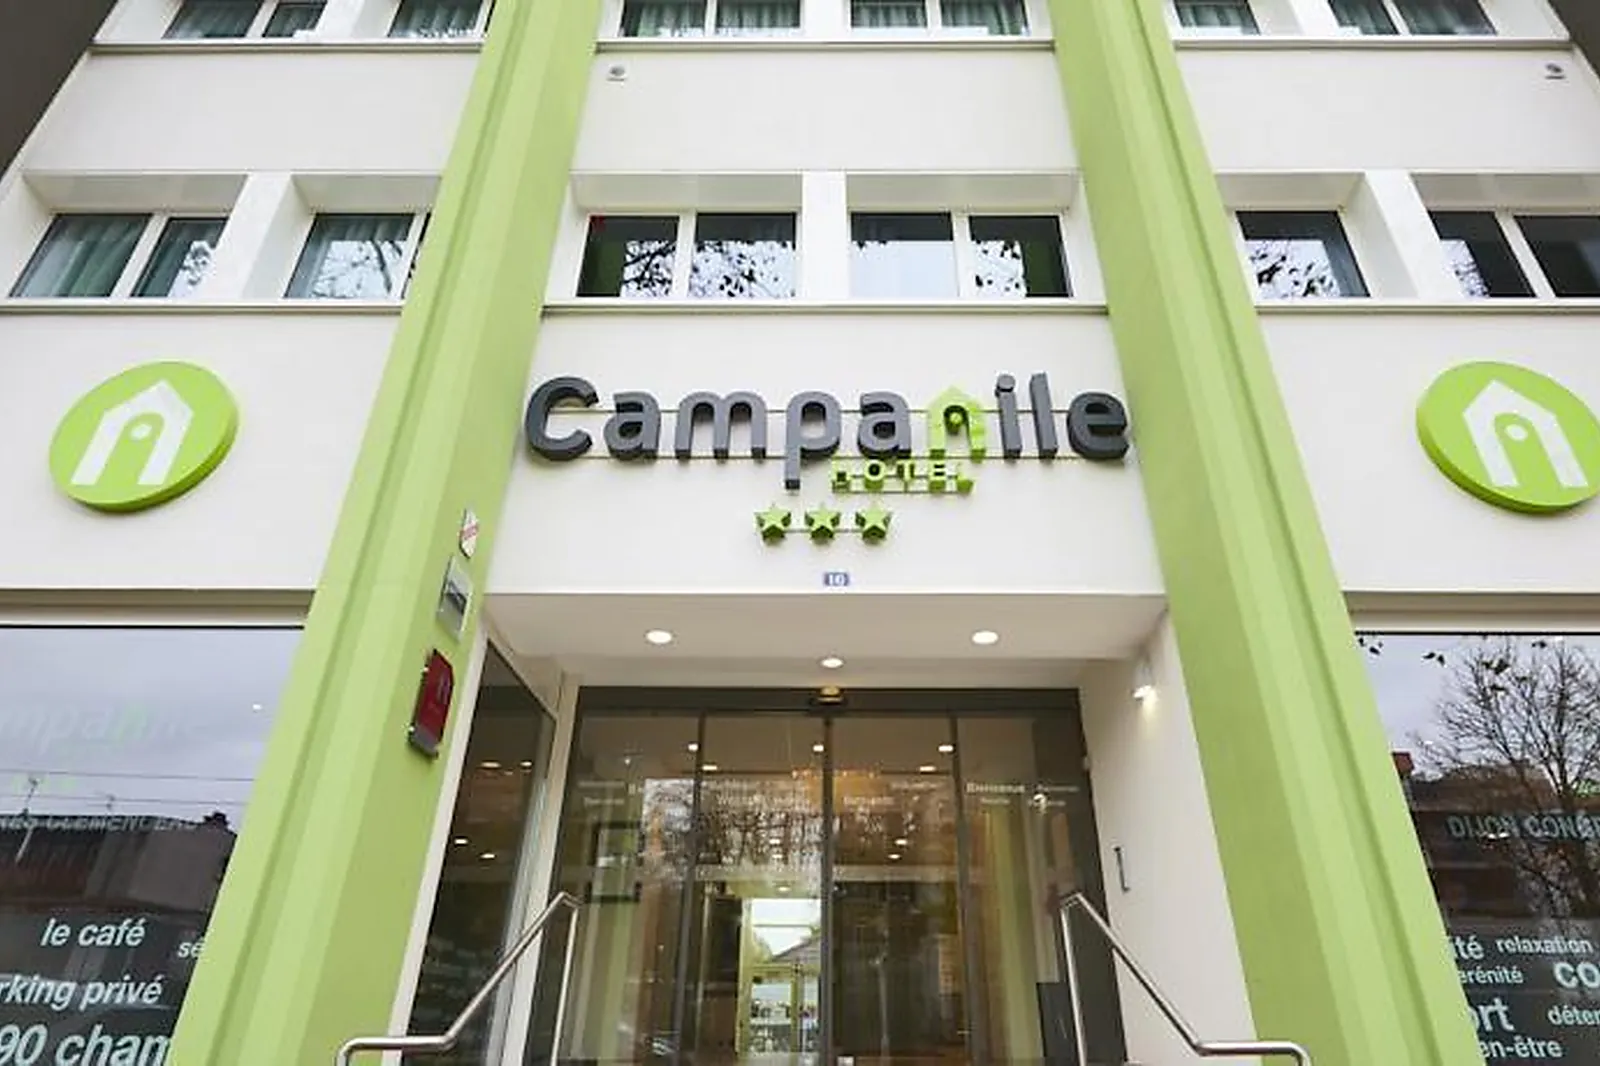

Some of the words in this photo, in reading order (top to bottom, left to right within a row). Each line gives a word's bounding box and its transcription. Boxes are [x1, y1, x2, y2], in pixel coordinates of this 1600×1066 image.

[525, 372, 1131, 491] Campanile
[831, 459, 974, 494] HOTEL
[1446, 813, 1520, 840] DIJON
[41, 918, 71, 947] le
[78, 918, 147, 947] café
[1496, 936, 1594, 955] relaxation
[79, 974, 164, 1011] privé
